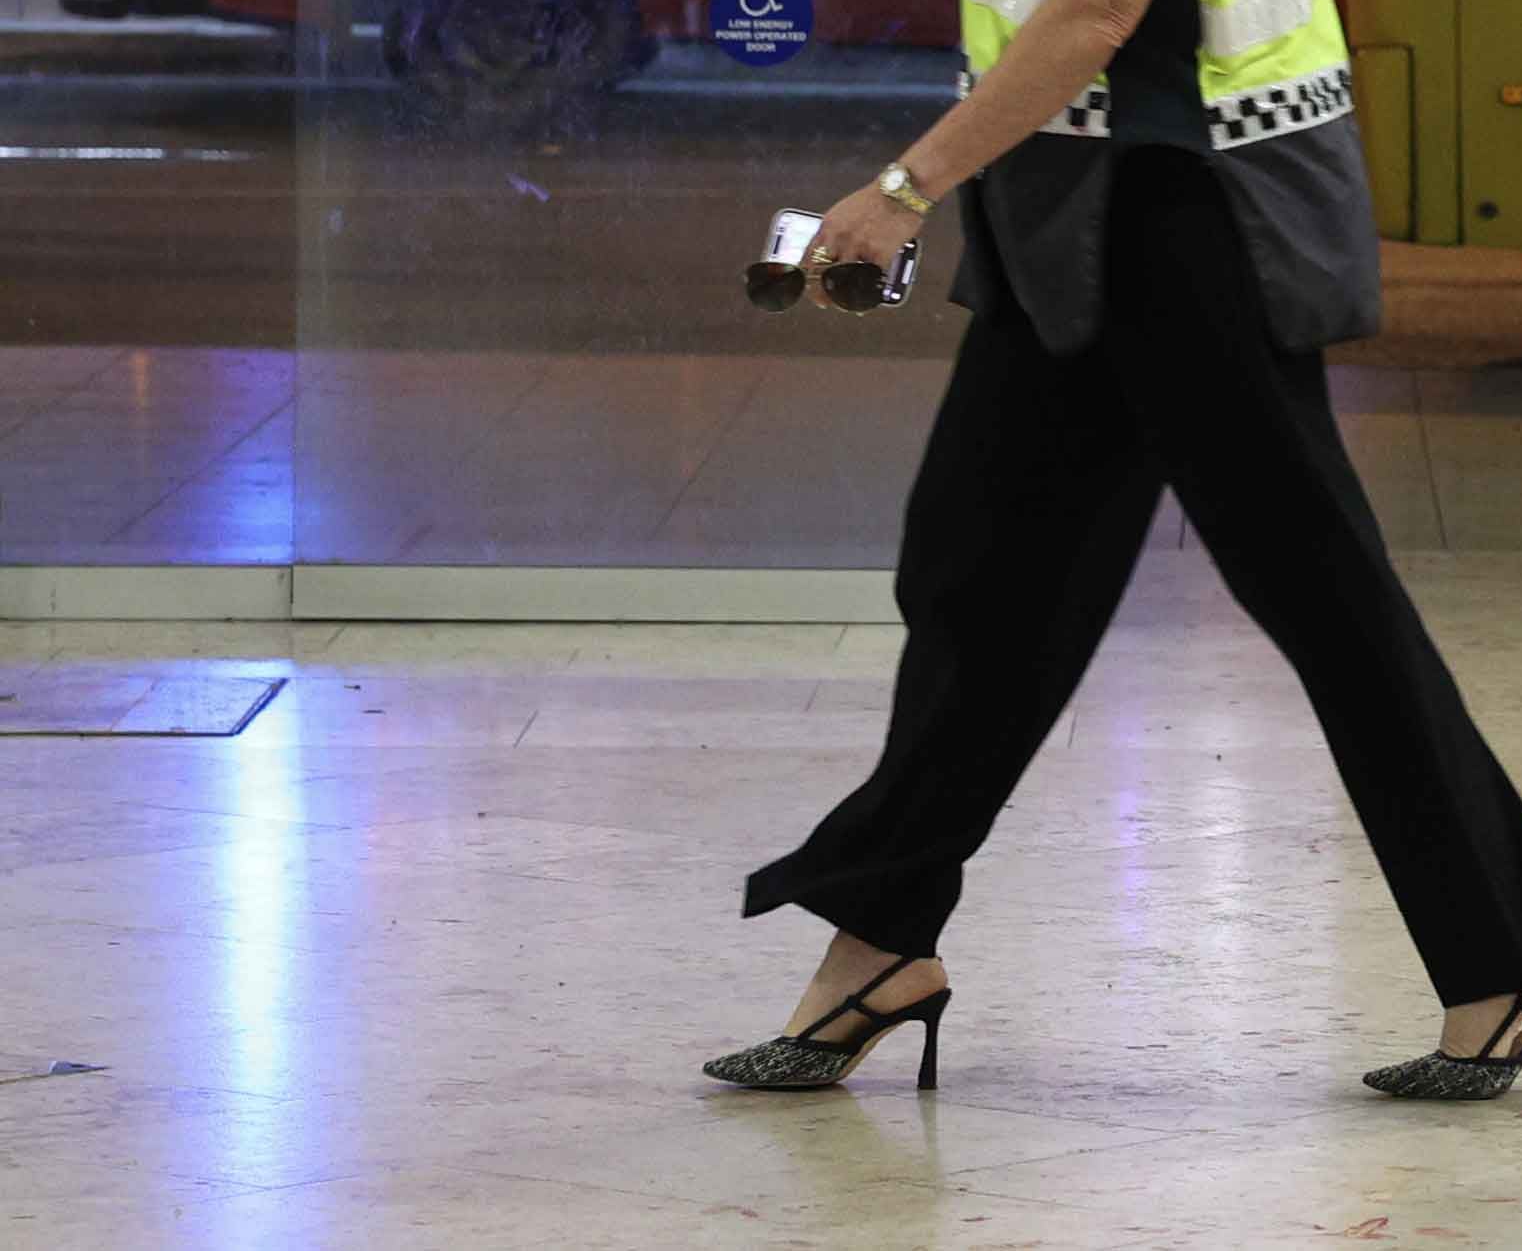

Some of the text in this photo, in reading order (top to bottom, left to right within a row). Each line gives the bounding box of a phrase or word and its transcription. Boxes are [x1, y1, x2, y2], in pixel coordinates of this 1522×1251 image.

[727, 18, 794, 30] LOW ENERGY
[715, 30, 807, 42] POWER OPERATED
[746, 42, 776, 53] DOOR
